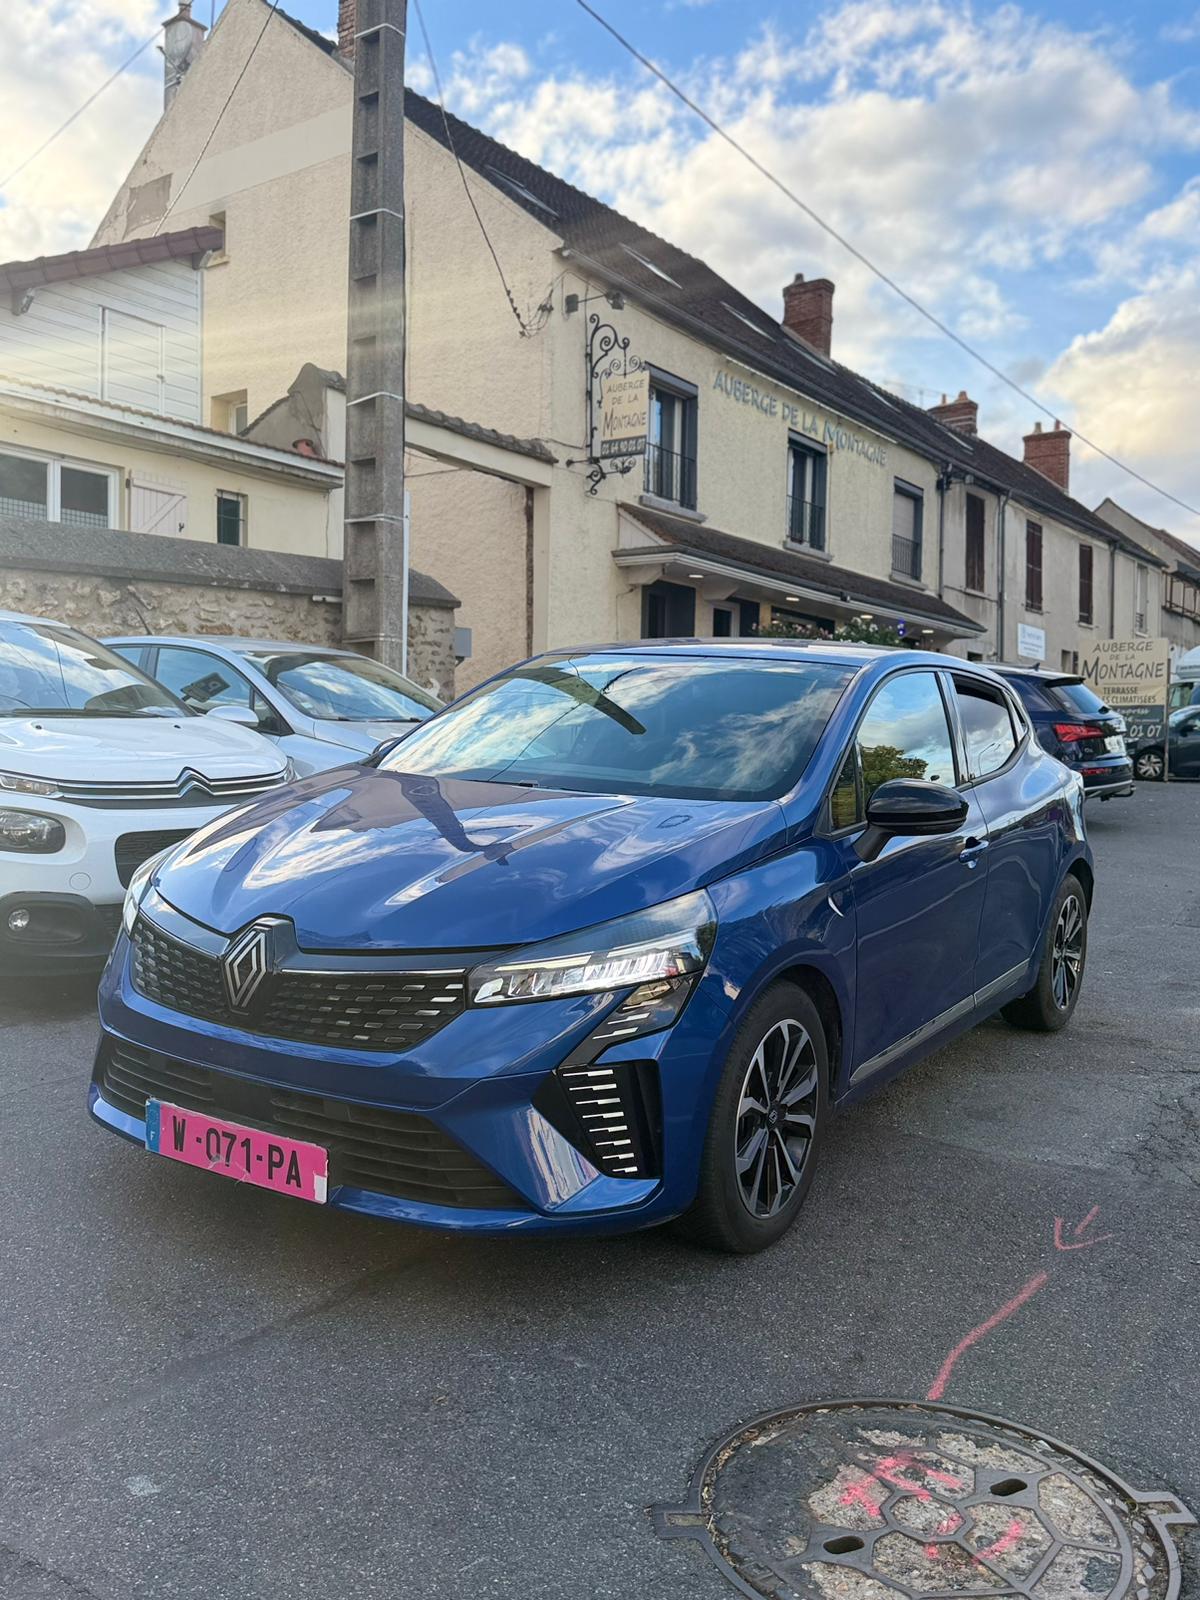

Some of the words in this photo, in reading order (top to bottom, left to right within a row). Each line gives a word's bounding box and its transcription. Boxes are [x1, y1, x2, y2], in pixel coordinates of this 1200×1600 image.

[607, 379, 645, 394] AUBERGE
[612, 396, 623, 406] DE
[628, 394, 639, 404] LA
[603, 408, 647, 438] MONTAGNE
[713, 370, 778, 416] AUBERGE
[782, 402, 799, 426] DE
[802, 411, 818, 435] LA
[823, 420, 887, 466] MONTAGNE
[1092, 641, 1154, 653] AUBERGE
[1081, 656, 1165, 686] MONTAGNE
[1103, 687, 1138, 695] TERRASSE
[1129, 724, 1144, 737] 01
[1147, 724, 1162, 737] 07
[150, 1130, 156, 1141] F
